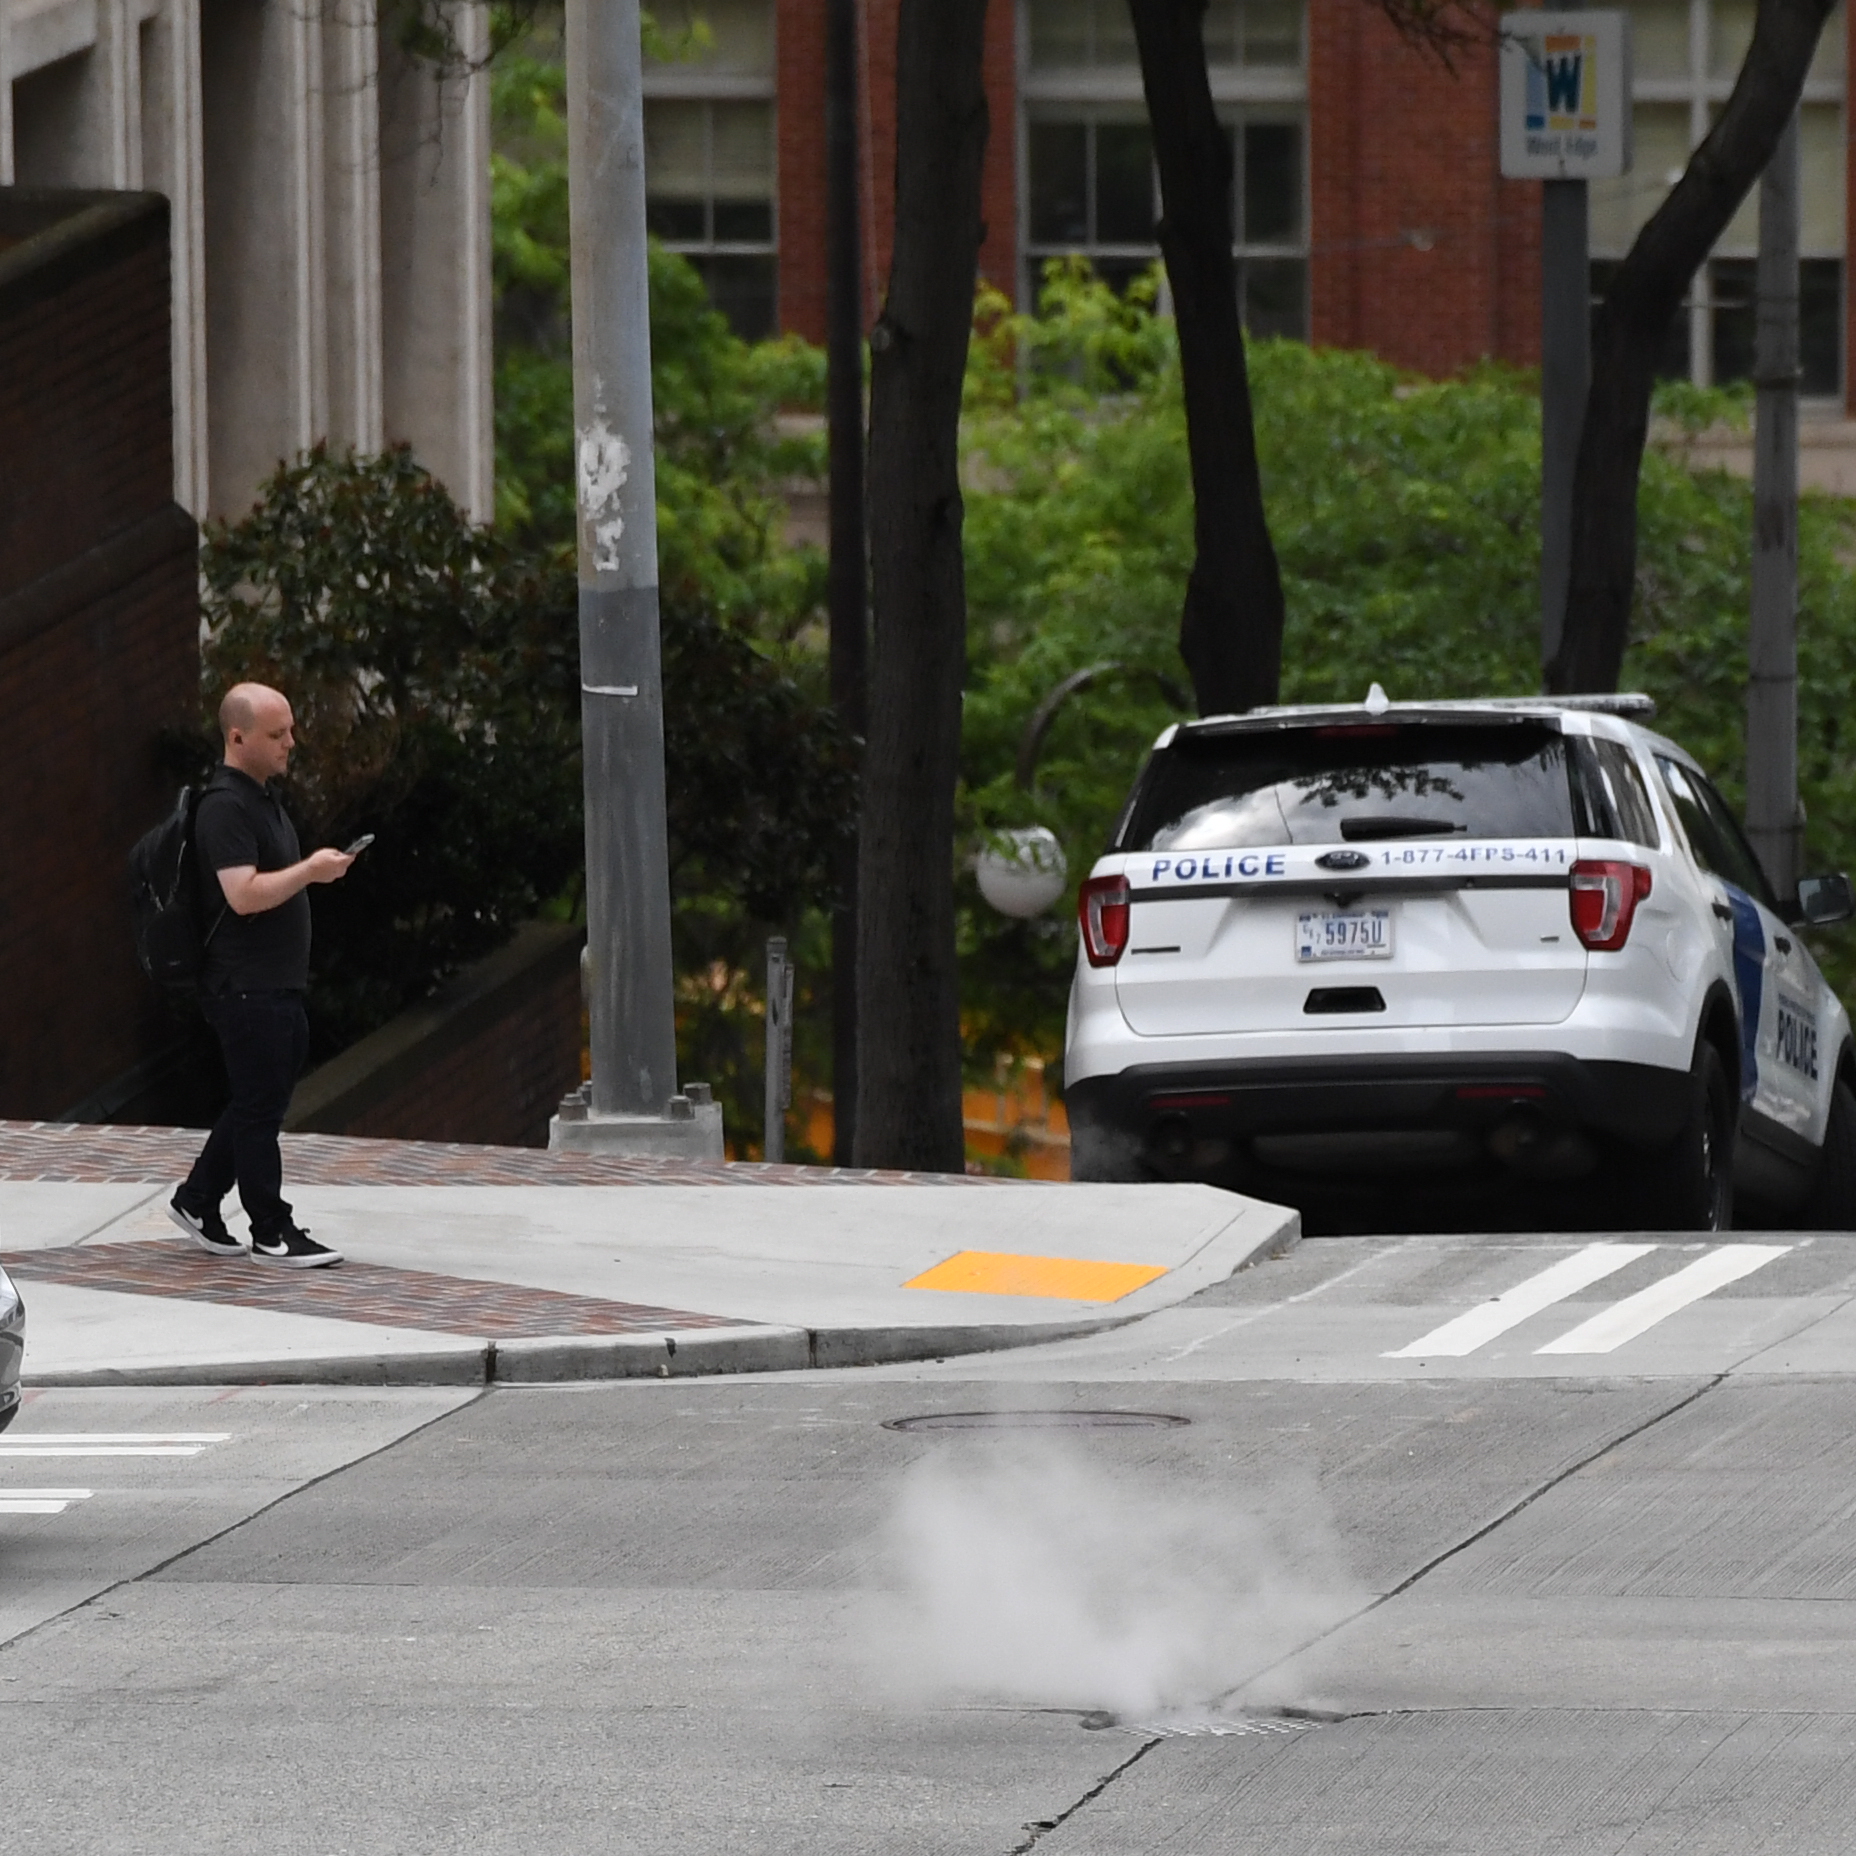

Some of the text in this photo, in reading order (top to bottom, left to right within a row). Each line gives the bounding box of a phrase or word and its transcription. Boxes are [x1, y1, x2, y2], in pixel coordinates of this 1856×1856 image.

[1152, 853, 1287, 882] POLICE
[1381, 846, 1566, 865] 1-877-4FPS-411
[1776, 1009, 1818, 1081] POLICE
